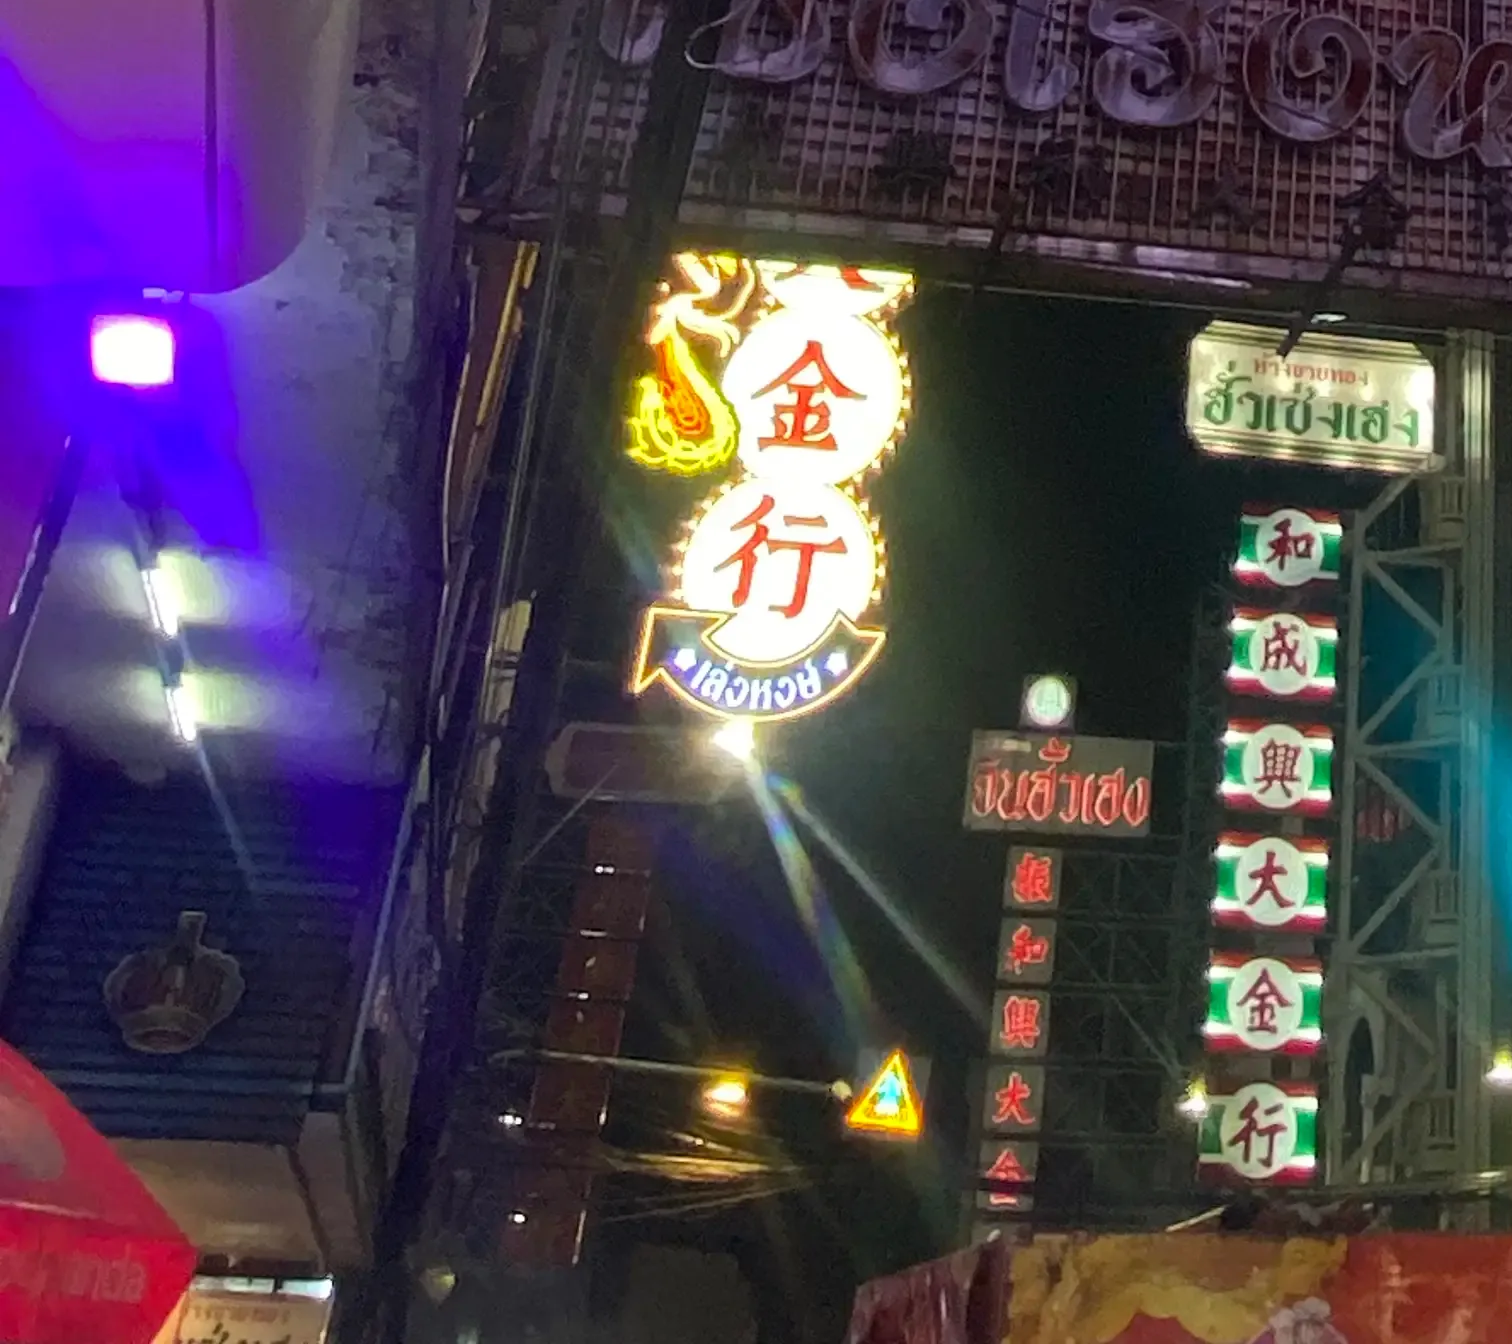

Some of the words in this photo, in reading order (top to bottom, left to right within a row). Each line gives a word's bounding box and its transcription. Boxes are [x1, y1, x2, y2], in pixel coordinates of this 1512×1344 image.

[1226, 515, 1317, 1168] 和成興大金行
